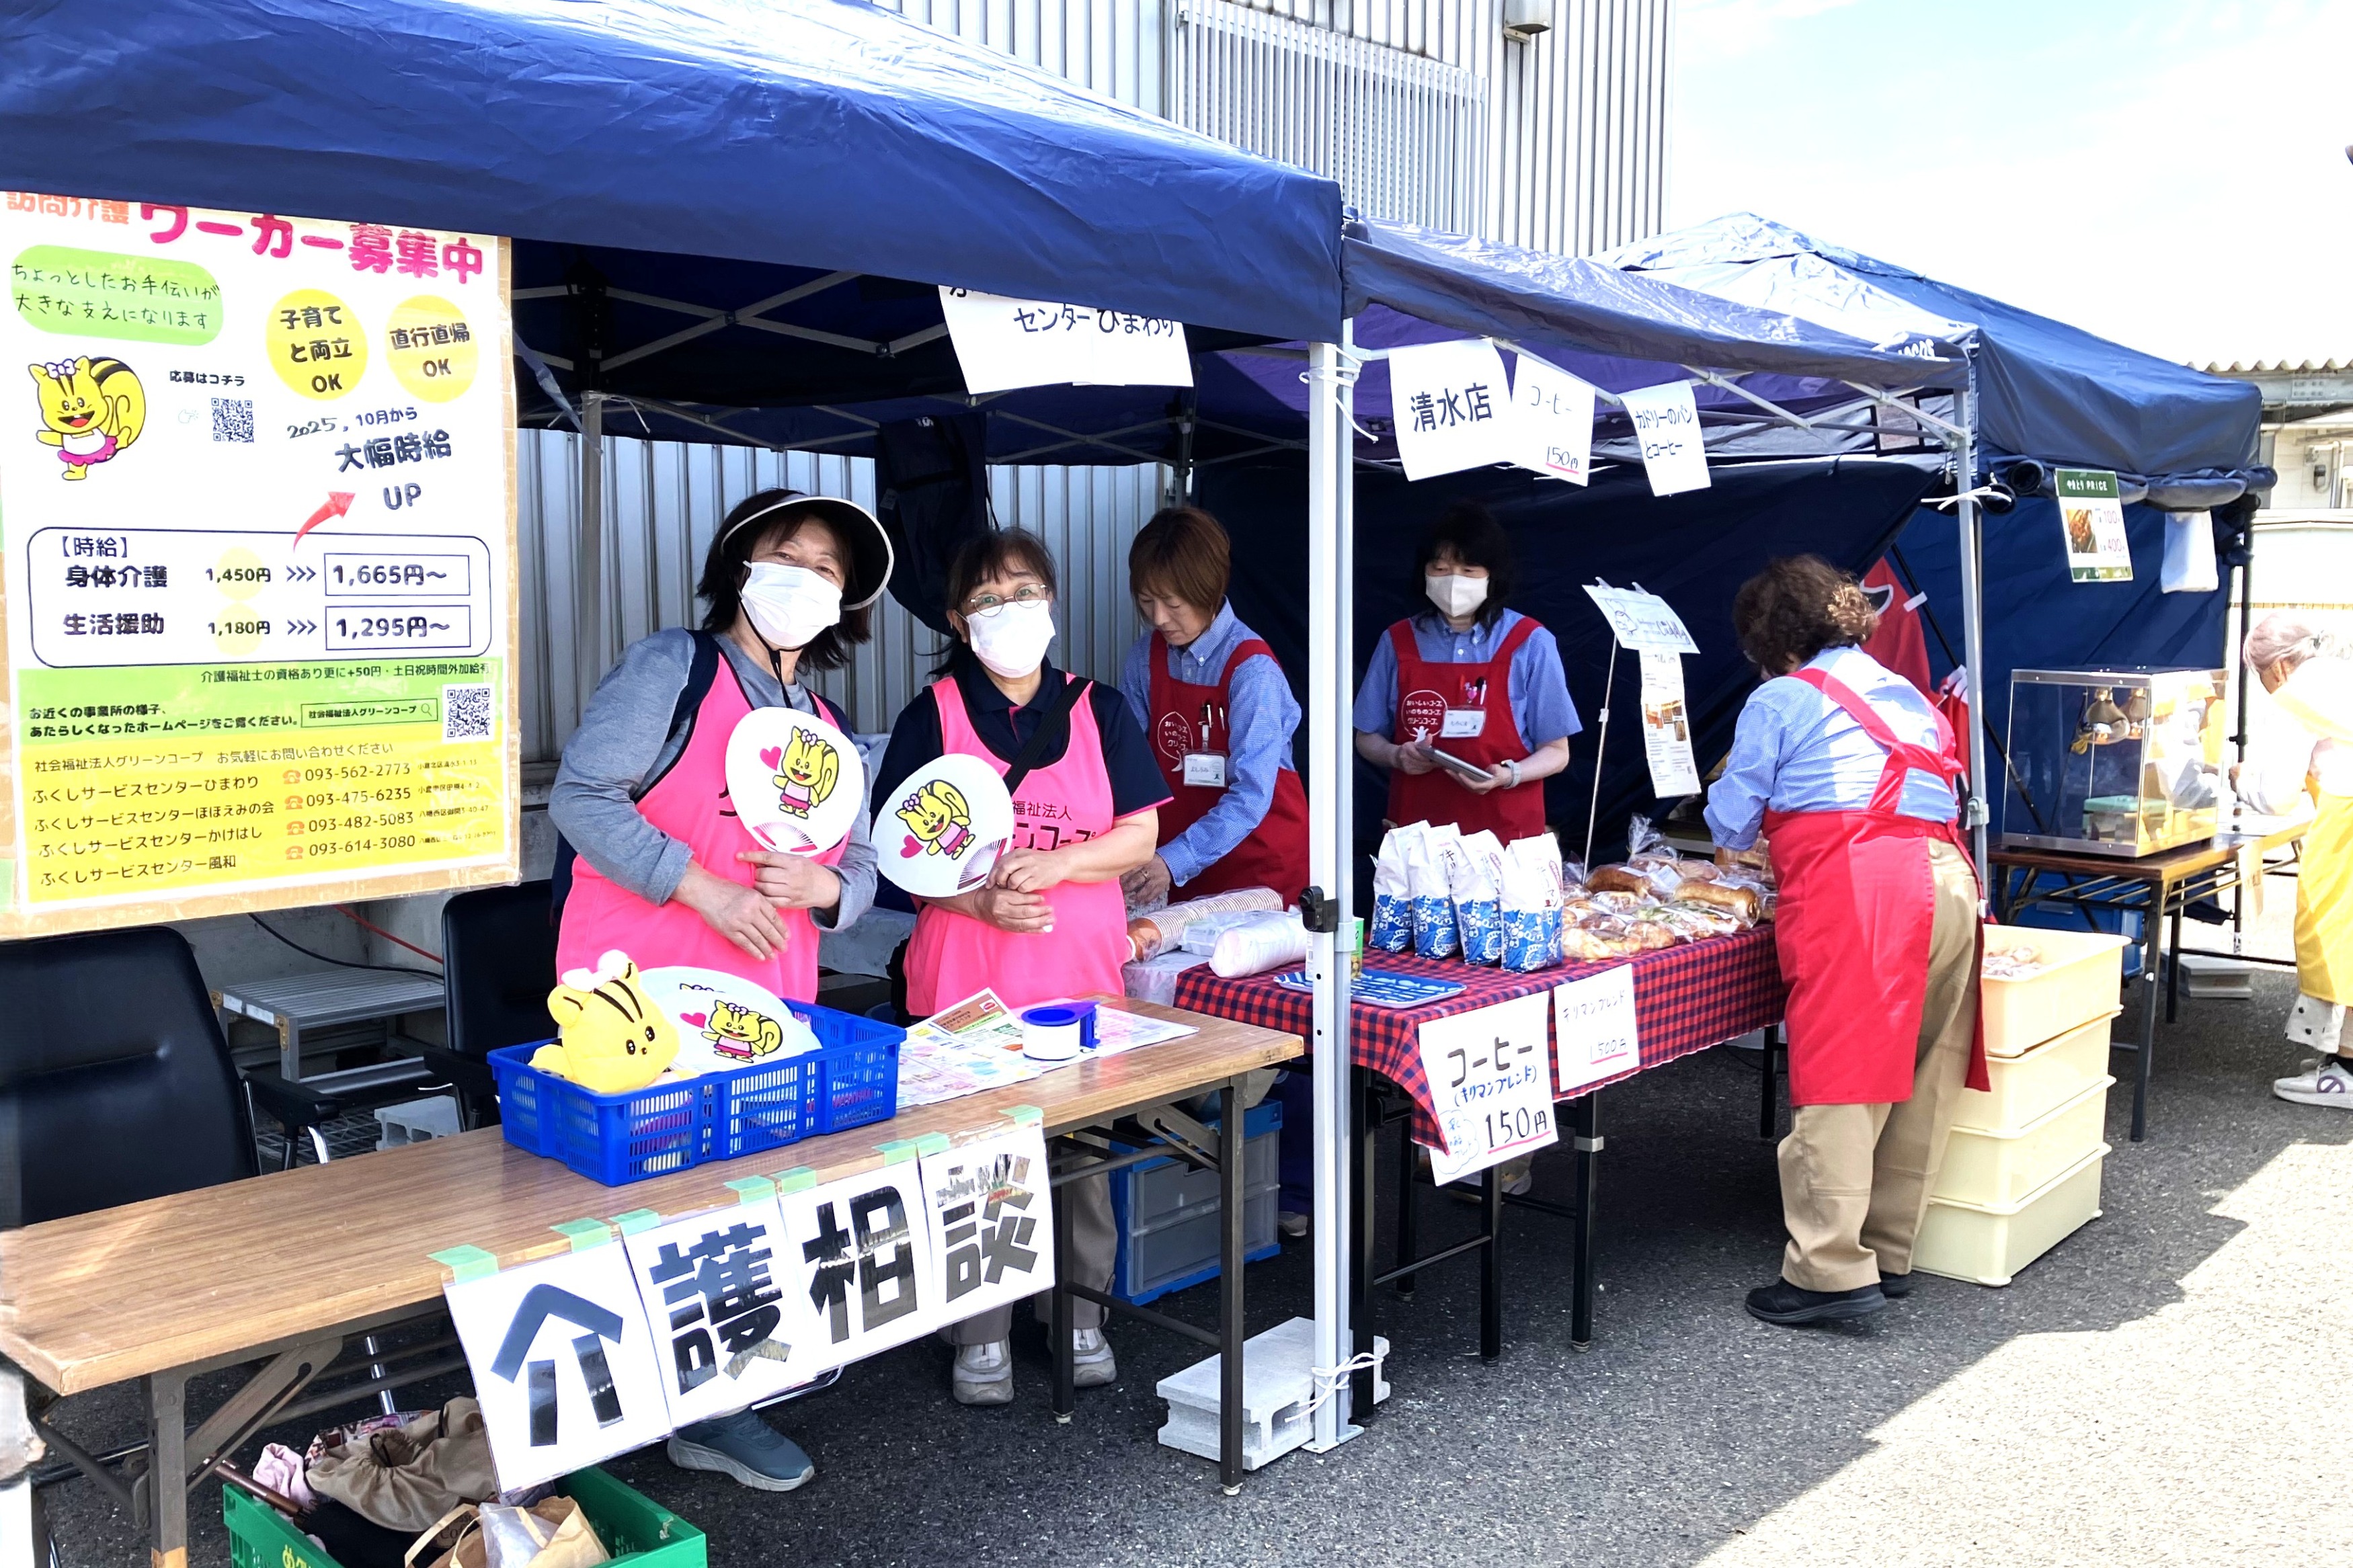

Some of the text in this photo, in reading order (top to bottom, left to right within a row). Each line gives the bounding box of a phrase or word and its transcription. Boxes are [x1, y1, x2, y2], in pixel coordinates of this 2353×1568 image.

[141, 202, 482, 284] ワーカー募集中
[11, 264, 220, 300] ちょっとしたお手伝いが
[16, 294, 208, 329] 大きな支えになります
[280, 305, 343, 329] 子育て
[290, 336, 353, 363] と両立
[390, 323, 470, 350] 直行直帰
[169, 370, 245, 387] 応募はコチラ
[422, 360, 452, 378] OK
[311, 374, 342, 393] OK
[1410, 382, 1493, 433] 清水店
[1530, 385, 1572, 415] コーヒー
[1635, 405, 1693, 430] カドリーのパン
[336, 429, 452, 472] 大幅時給
[1546, 446, 1579, 470] 150円
[1645, 440, 1683, 460] とコーヒー
[383, 483, 422, 511] UP
[2086, 481, 2108, 491] PRICE
[61, 536, 128, 559] 【時給】
[66, 565, 168, 589] 身体介護
[205, 566, 272, 584] 1,450円
[63, 612, 165, 636] 生活援助
[208, 619, 271, 636] 1,180円
[29, 704, 167, 720] お近くの事業所の様子、
[309, 705, 417, 719] 社会福祉法人グリーンコープ
[30, 716, 298, 737] あたらしくなったホームページをご覧ください。
[35, 742, 394, 773] 社会福祉法人グリーンコープ お気軽にお問い合わせください
[32, 776, 260, 804] ふくしサービスセンターひまわり
[305, 761, 411, 782] 093-562-2773
[34, 801, 275, 833] ふくしサービスセンターほほえみの会
[307, 786, 411, 807] 093-475-6235
[1012, 800, 1072, 821] 福祉法人
[38, 827, 263, 858] ふくしサービスセンターかけはし
[308, 811, 414, 833] 093-482-5083
[40, 855, 237, 886] ふくしサービスセンター風和
[309, 835, 415, 858] 093-614-3080
[1447, 1036, 1533, 1087] コーヒー
[1589, 1038, 1628, 1061] 1500円
[1484, 1106, 1548, 1149] 150円
[490, 1153, 1039, 1448] 介護相談
